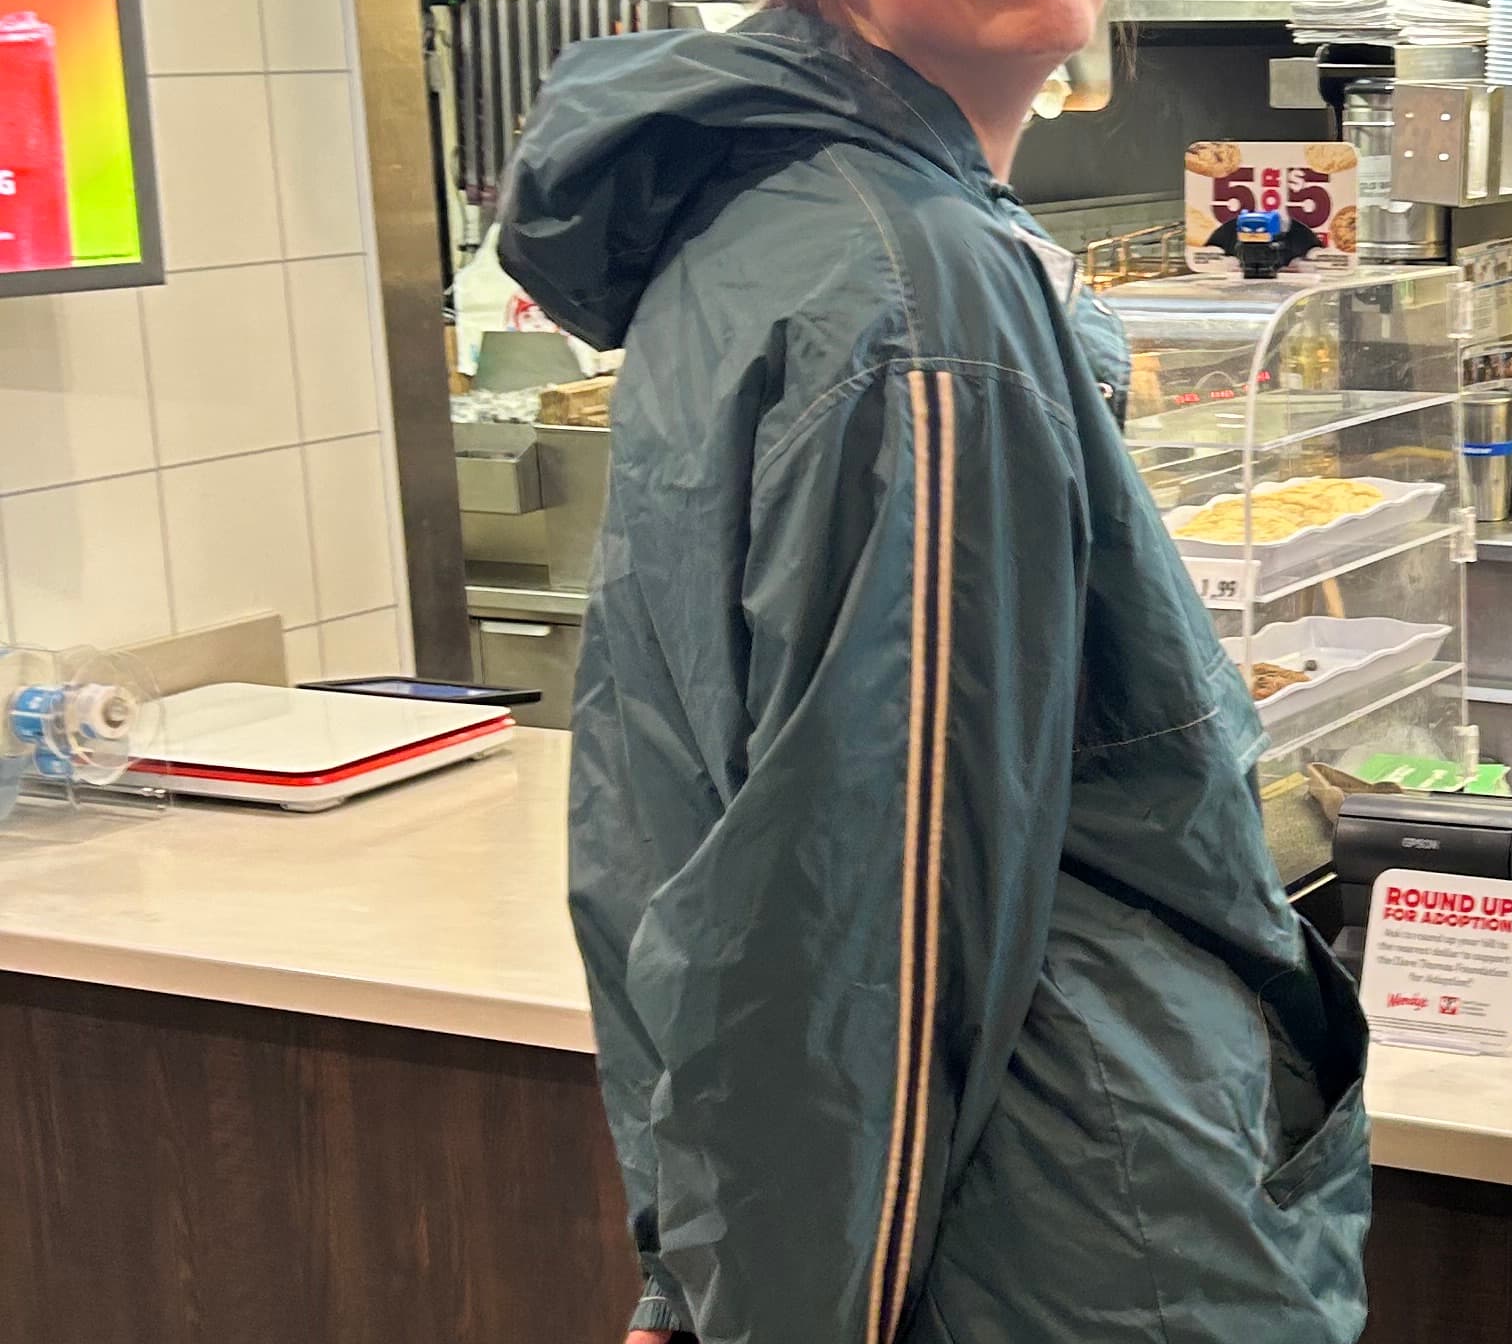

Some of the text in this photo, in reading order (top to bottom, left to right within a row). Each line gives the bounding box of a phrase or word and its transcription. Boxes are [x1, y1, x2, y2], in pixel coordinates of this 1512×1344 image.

[1211, 167, 1256, 226] 5
[1386, 886, 1475, 913] ROUND
[1383, 907, 1417, 921] FOR
